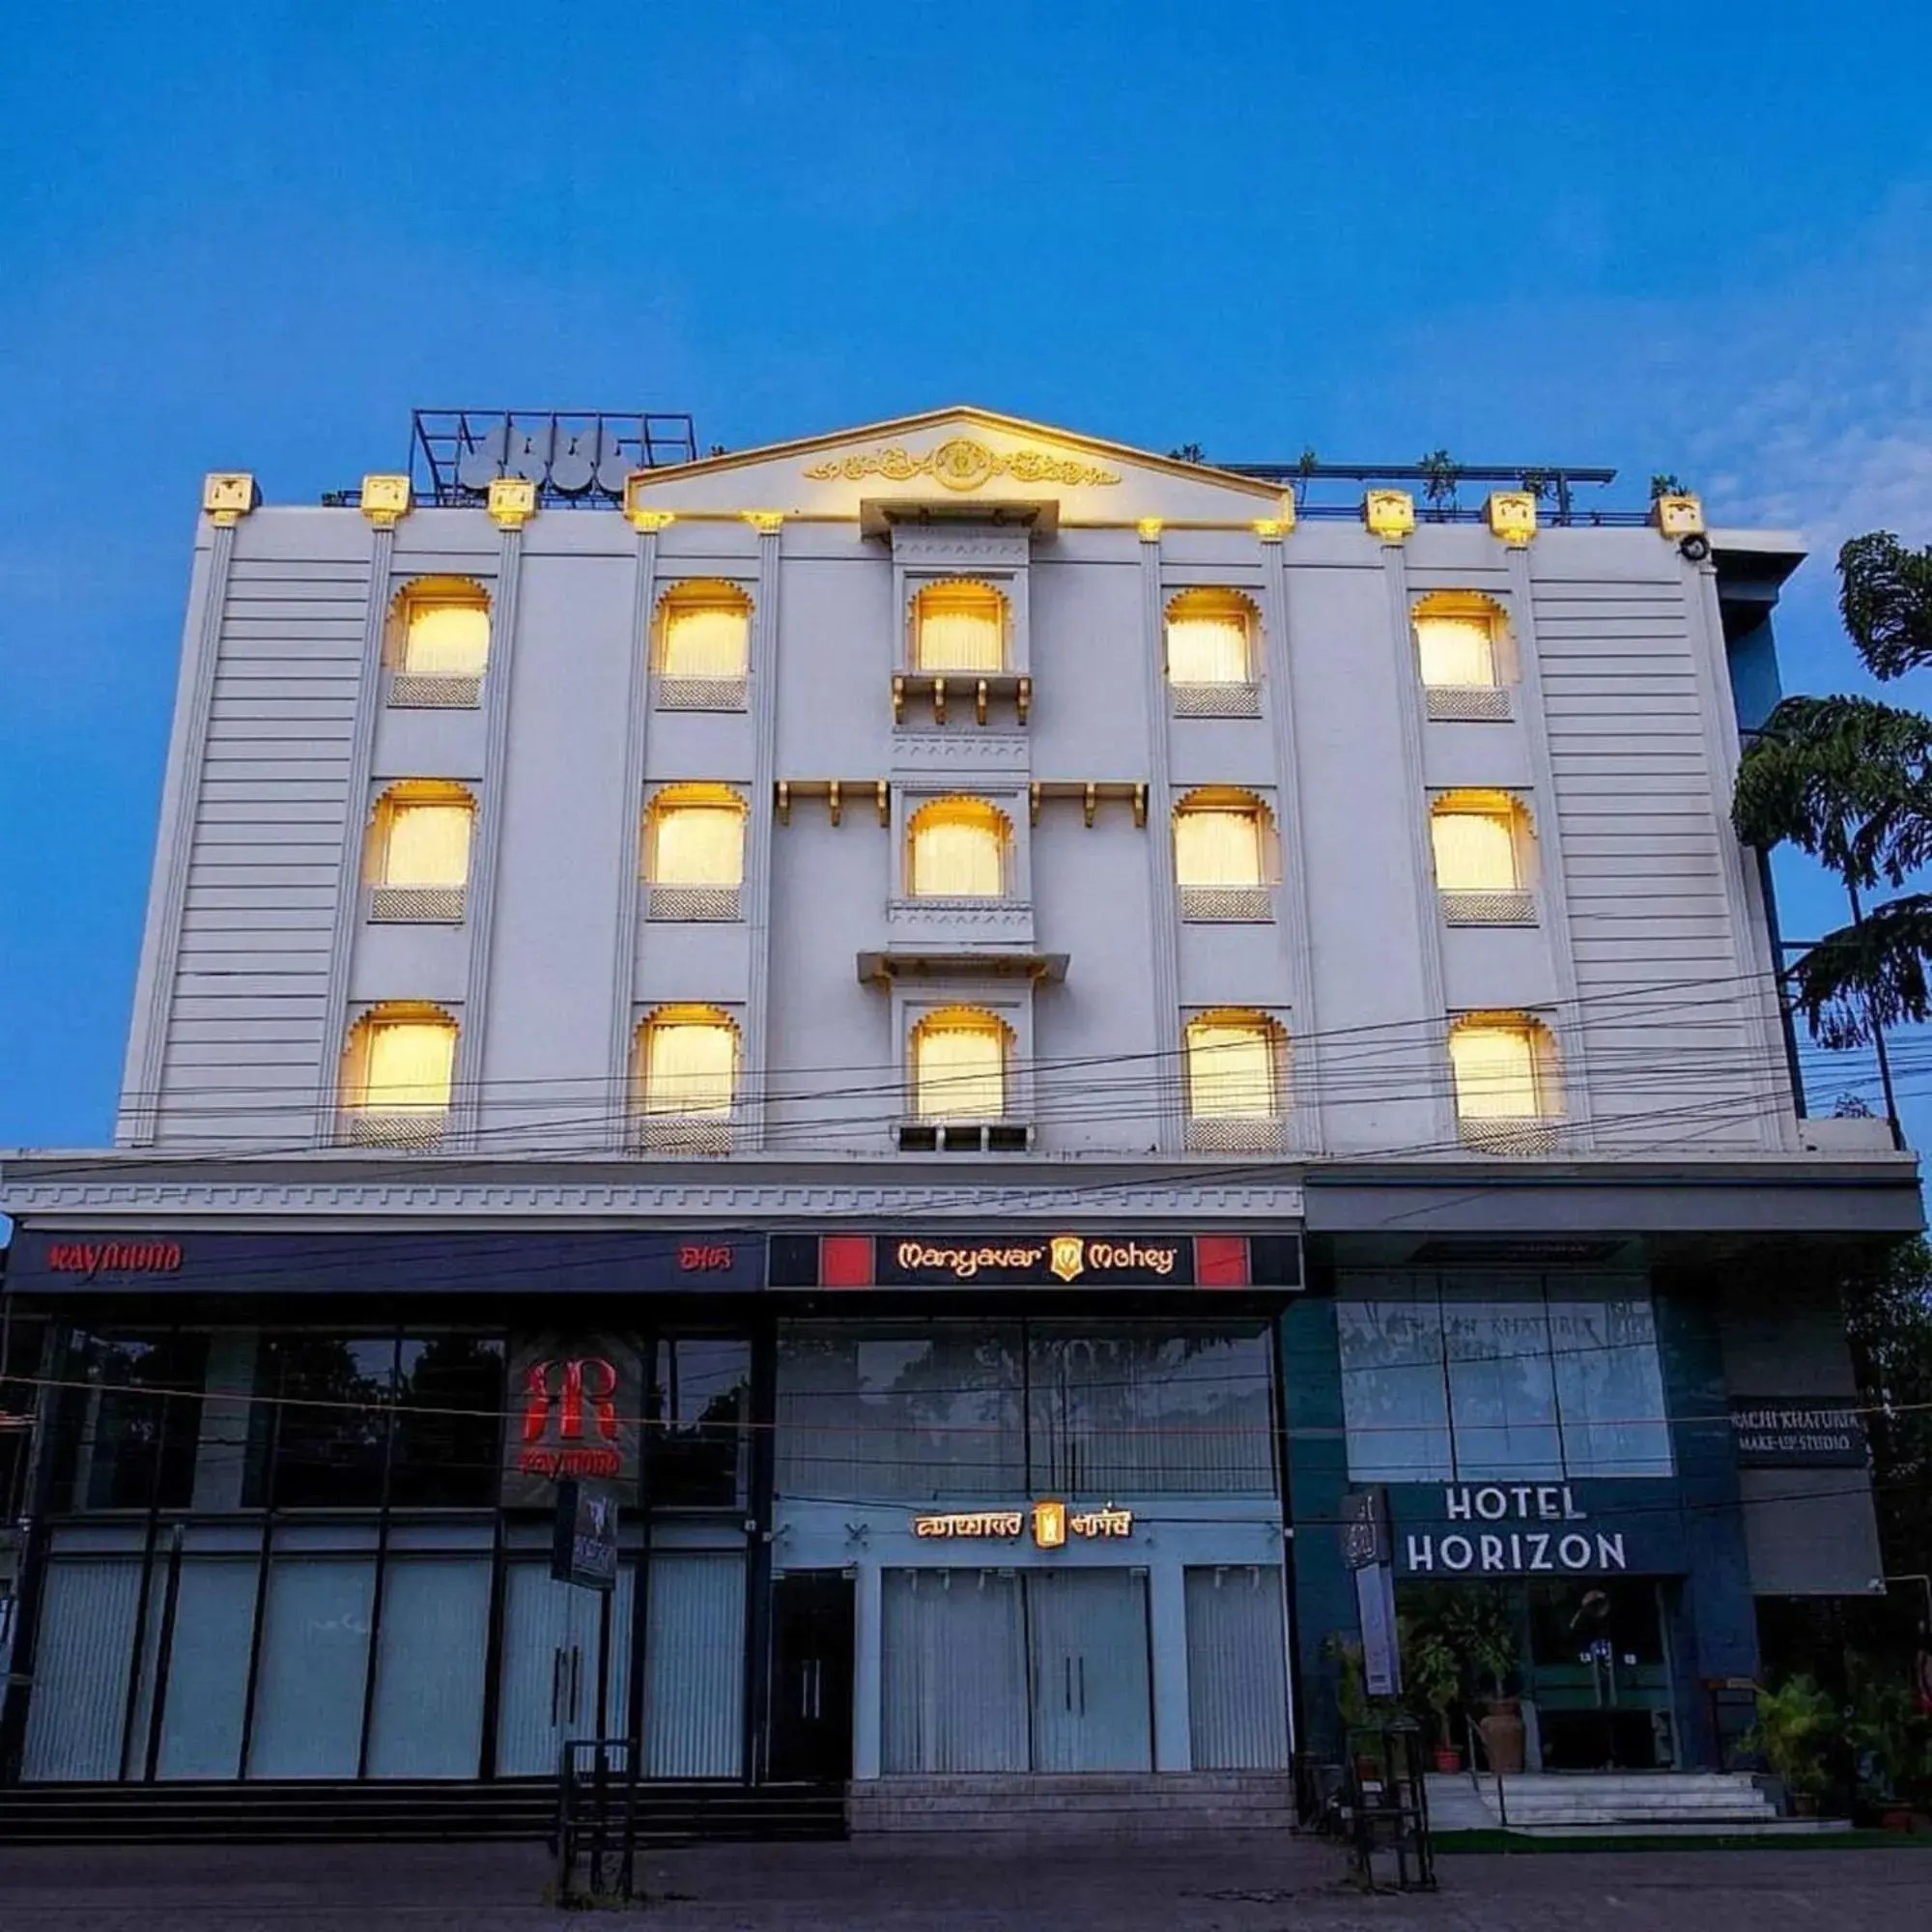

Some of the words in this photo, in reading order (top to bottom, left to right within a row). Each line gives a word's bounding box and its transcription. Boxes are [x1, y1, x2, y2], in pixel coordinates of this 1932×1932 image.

[897, 1241, 1041, 1277] Manyavar
[1089, 1241, 1175, 1274] Mohey
[1799, 1434, 1850, 1450] STUDIO
[1445, 1486, 1587, 1520] HOTEL
[1406, 1532, 1627, 1572] HORIZON
